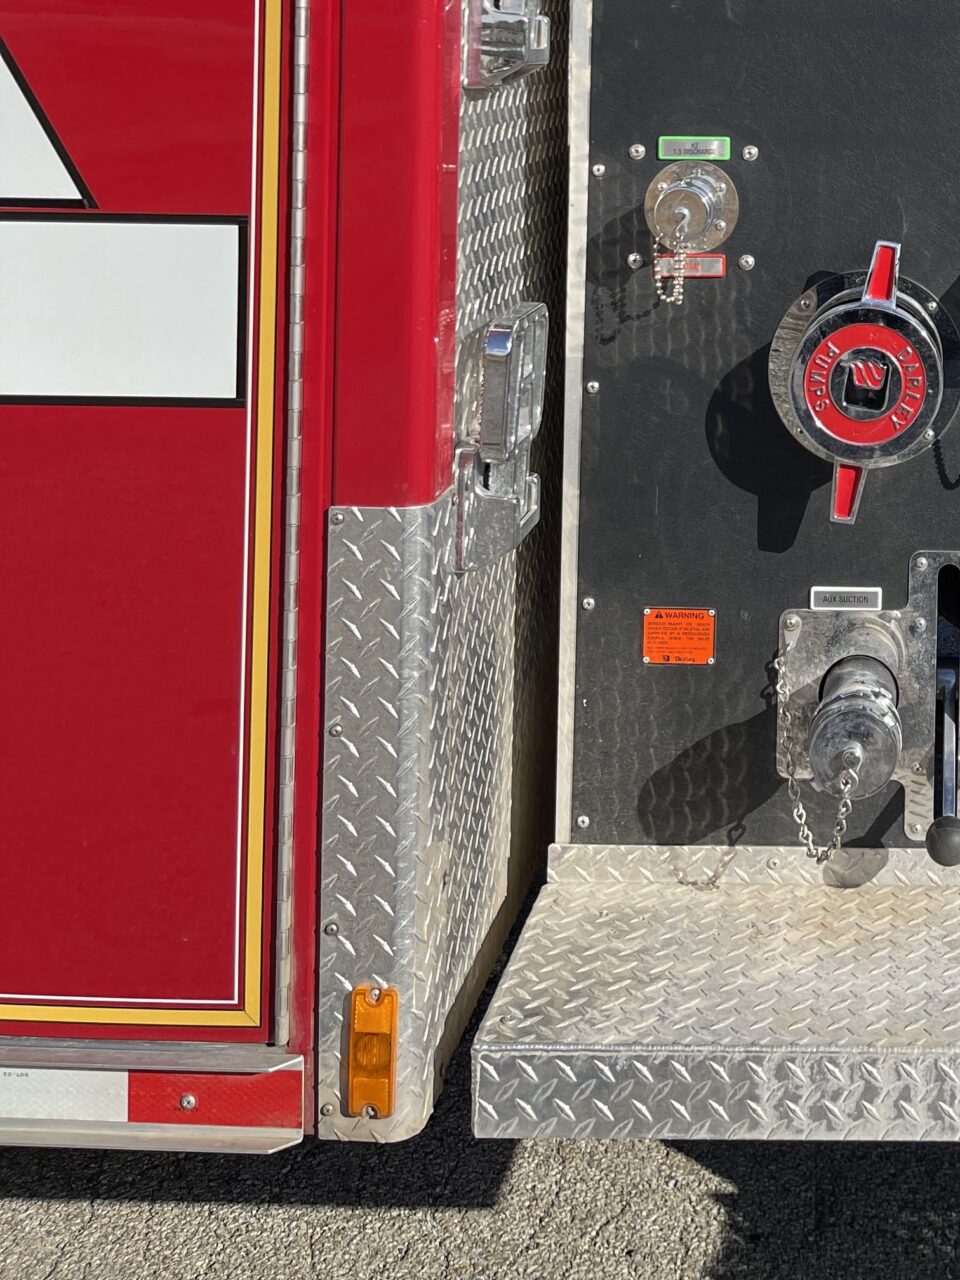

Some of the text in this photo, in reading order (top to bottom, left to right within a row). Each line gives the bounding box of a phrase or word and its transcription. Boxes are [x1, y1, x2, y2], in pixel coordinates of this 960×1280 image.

[809, 341, 840, 412] PUMPS
[890, 346, 923, 430] DARLEY
[822, 595, 869, 604] AUX SUCTION
